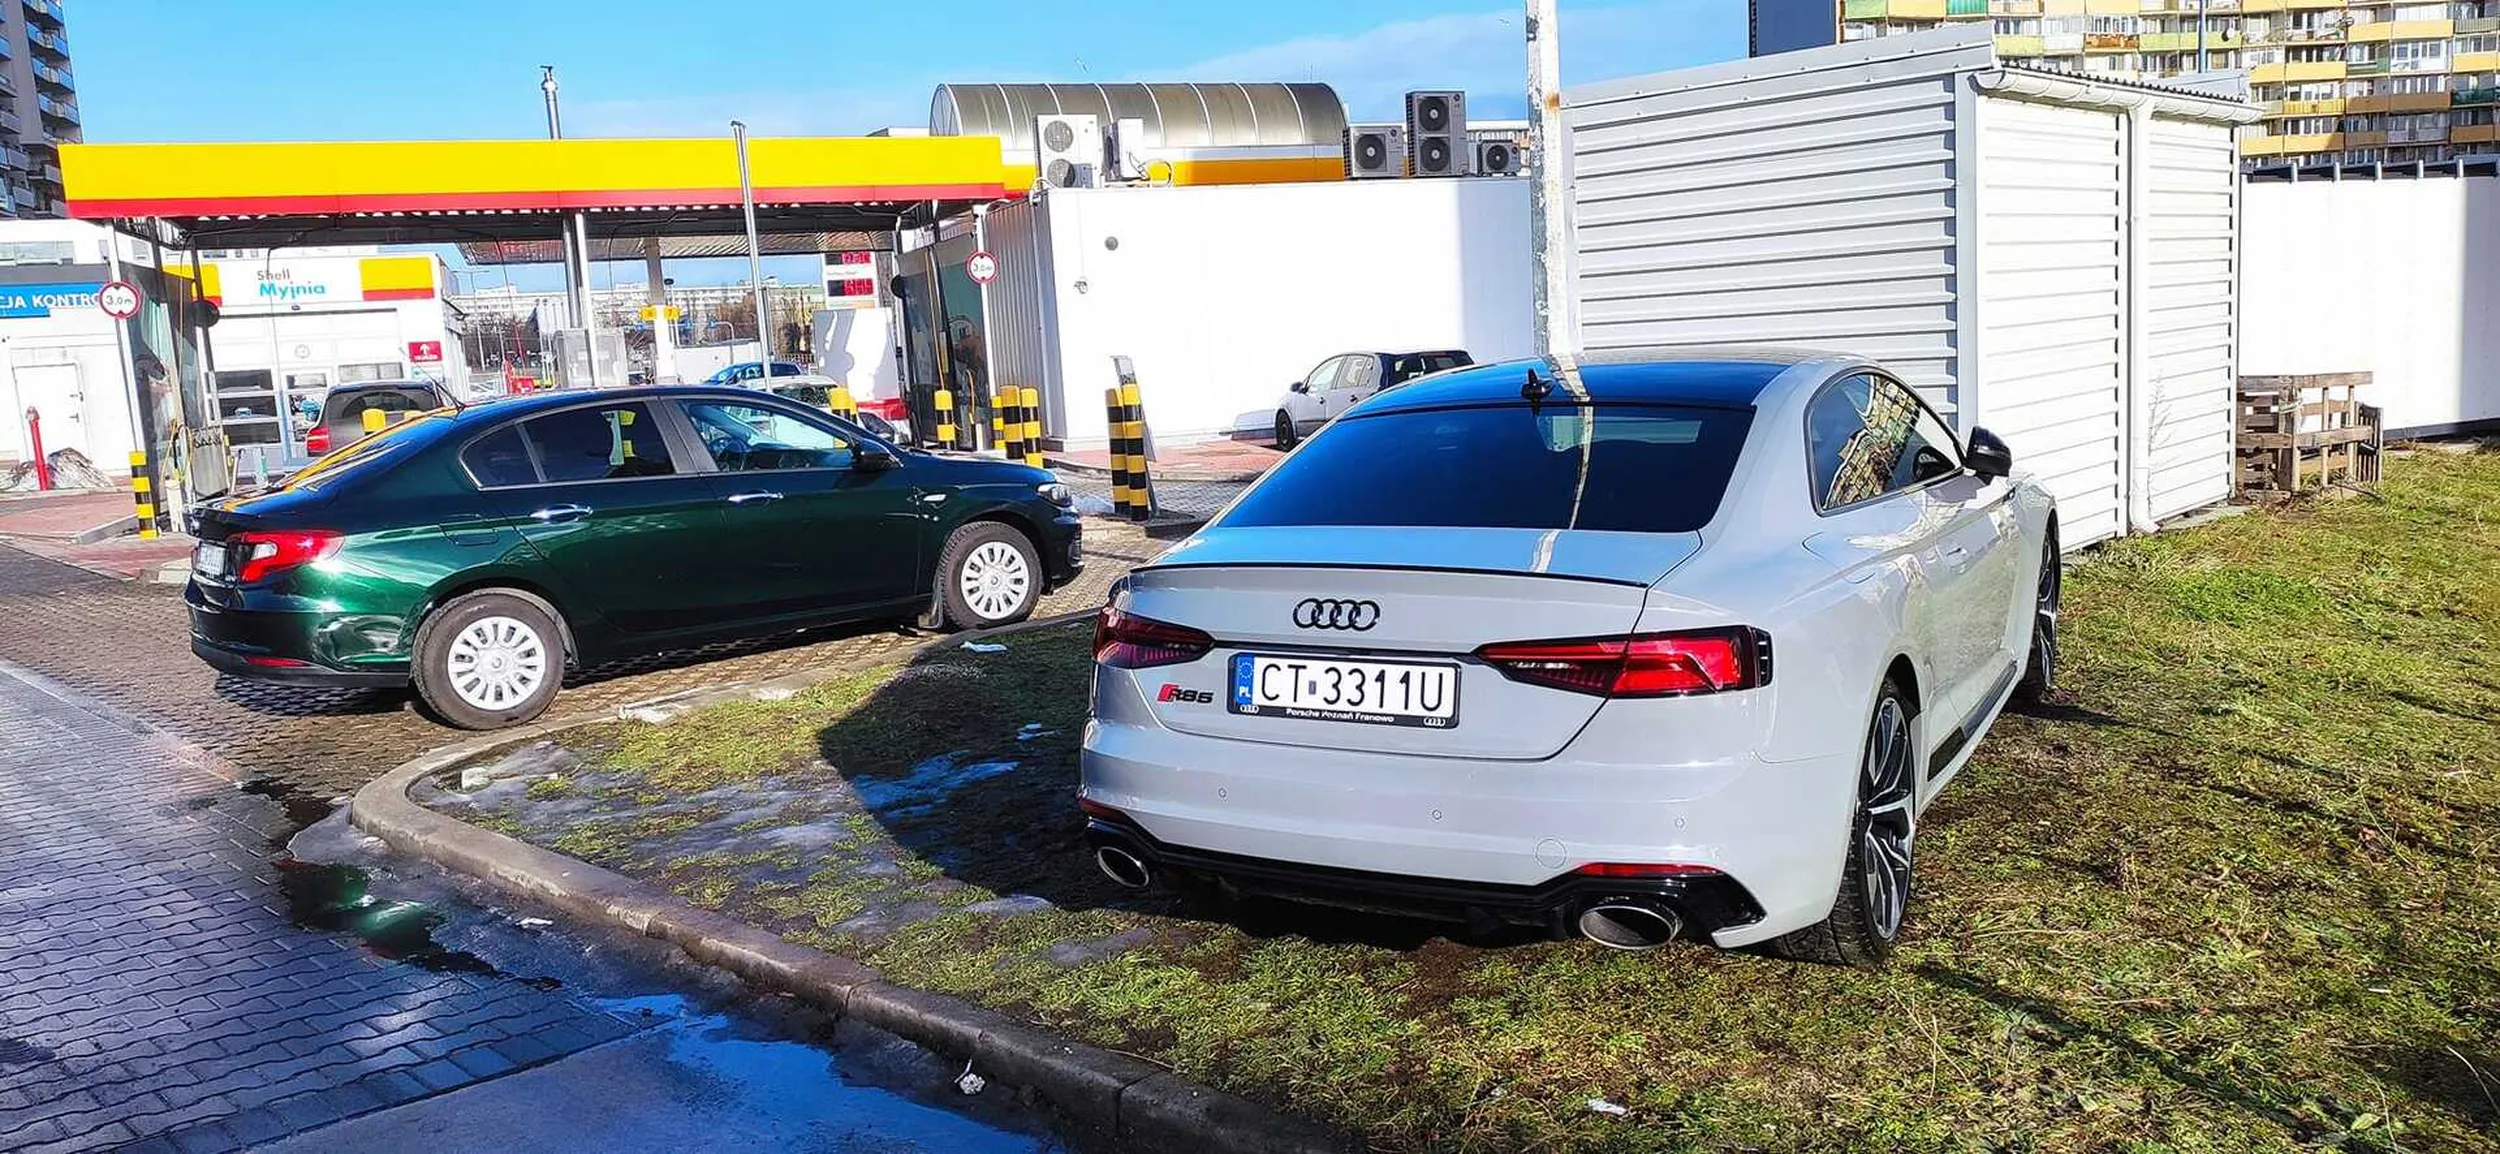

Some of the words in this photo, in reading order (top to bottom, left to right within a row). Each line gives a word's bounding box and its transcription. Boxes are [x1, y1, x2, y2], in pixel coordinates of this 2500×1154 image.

[257, 268, 290, 280] Shell
[259, 280, 326, 300] Myjnia
[1238, 686, 1251, 698] PL
[1261, 664, 1307, 702] CT
[1323, 667, 1443, 711] 3311U
